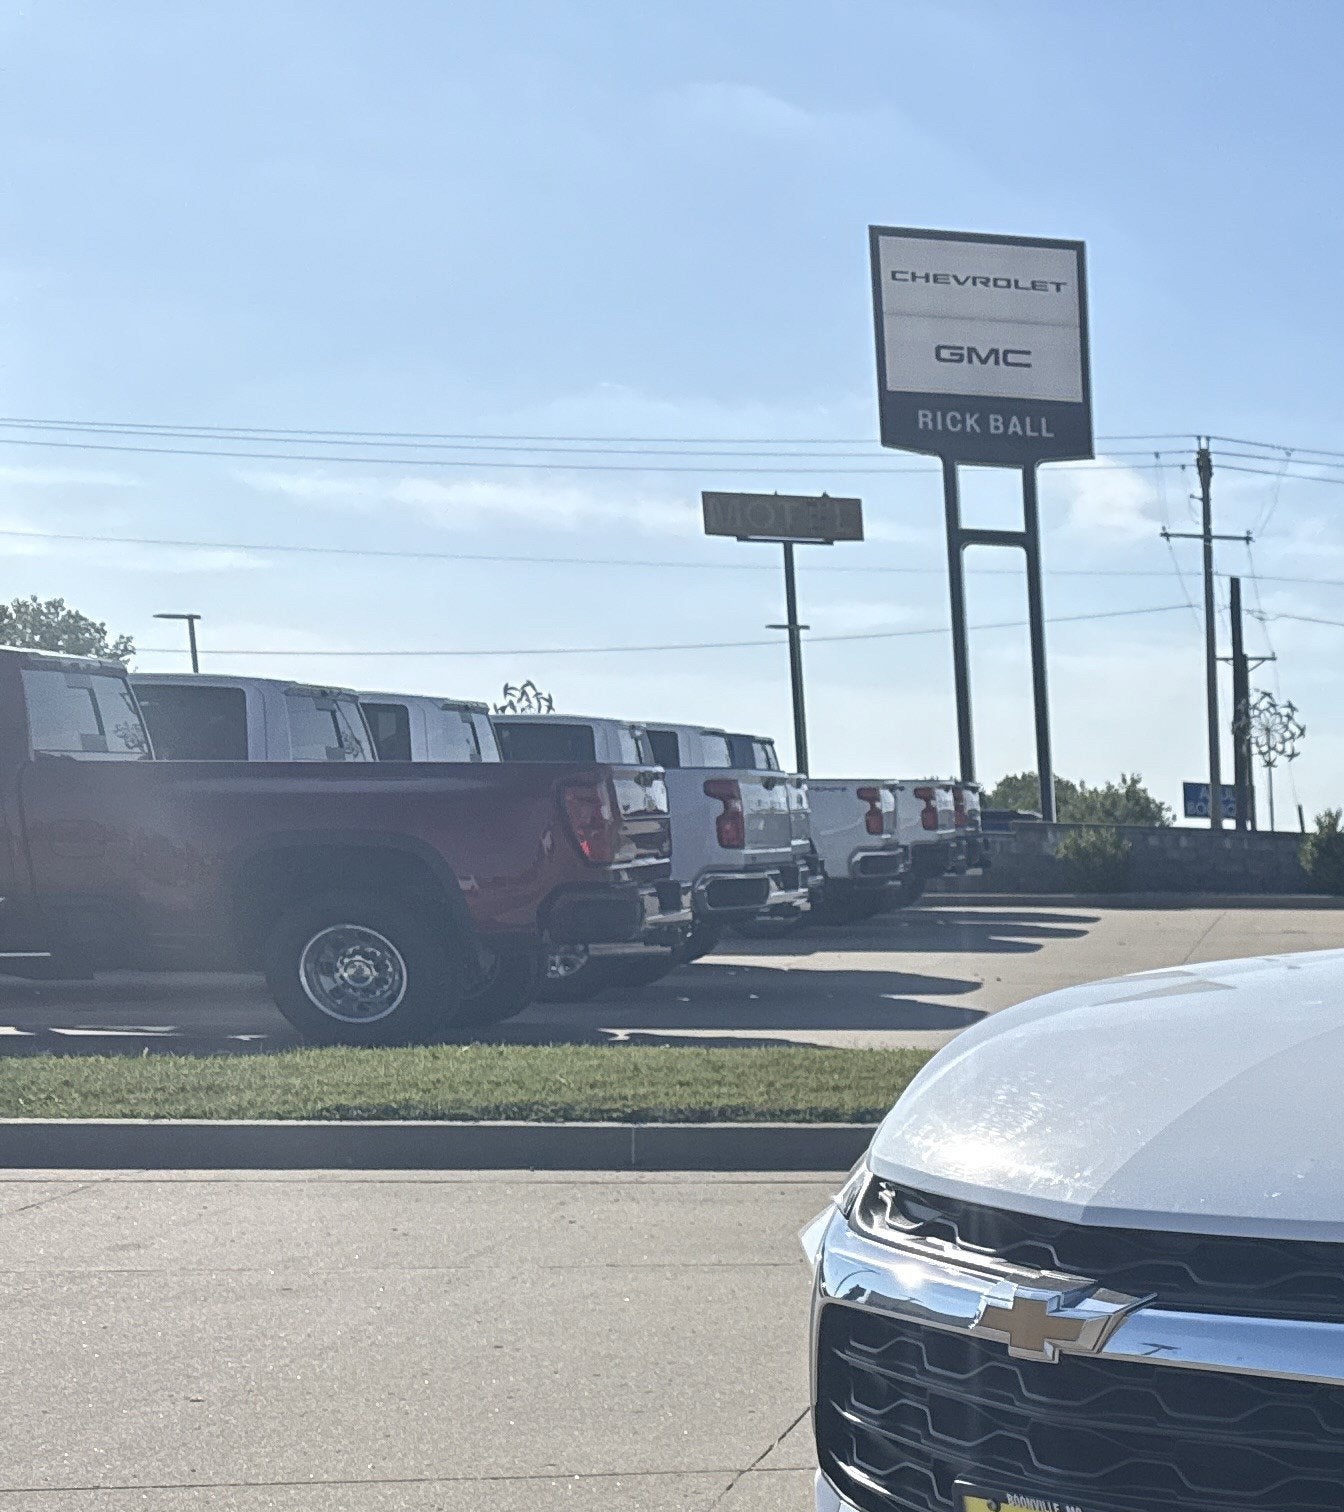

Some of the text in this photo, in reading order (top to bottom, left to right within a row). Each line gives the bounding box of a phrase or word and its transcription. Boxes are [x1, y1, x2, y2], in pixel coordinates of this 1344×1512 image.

[890, 270, 1068, 293] CHEVROLET
[934, 344, 1033, 368] GMC
[917, 409, 1055, 438] RICK BALL
